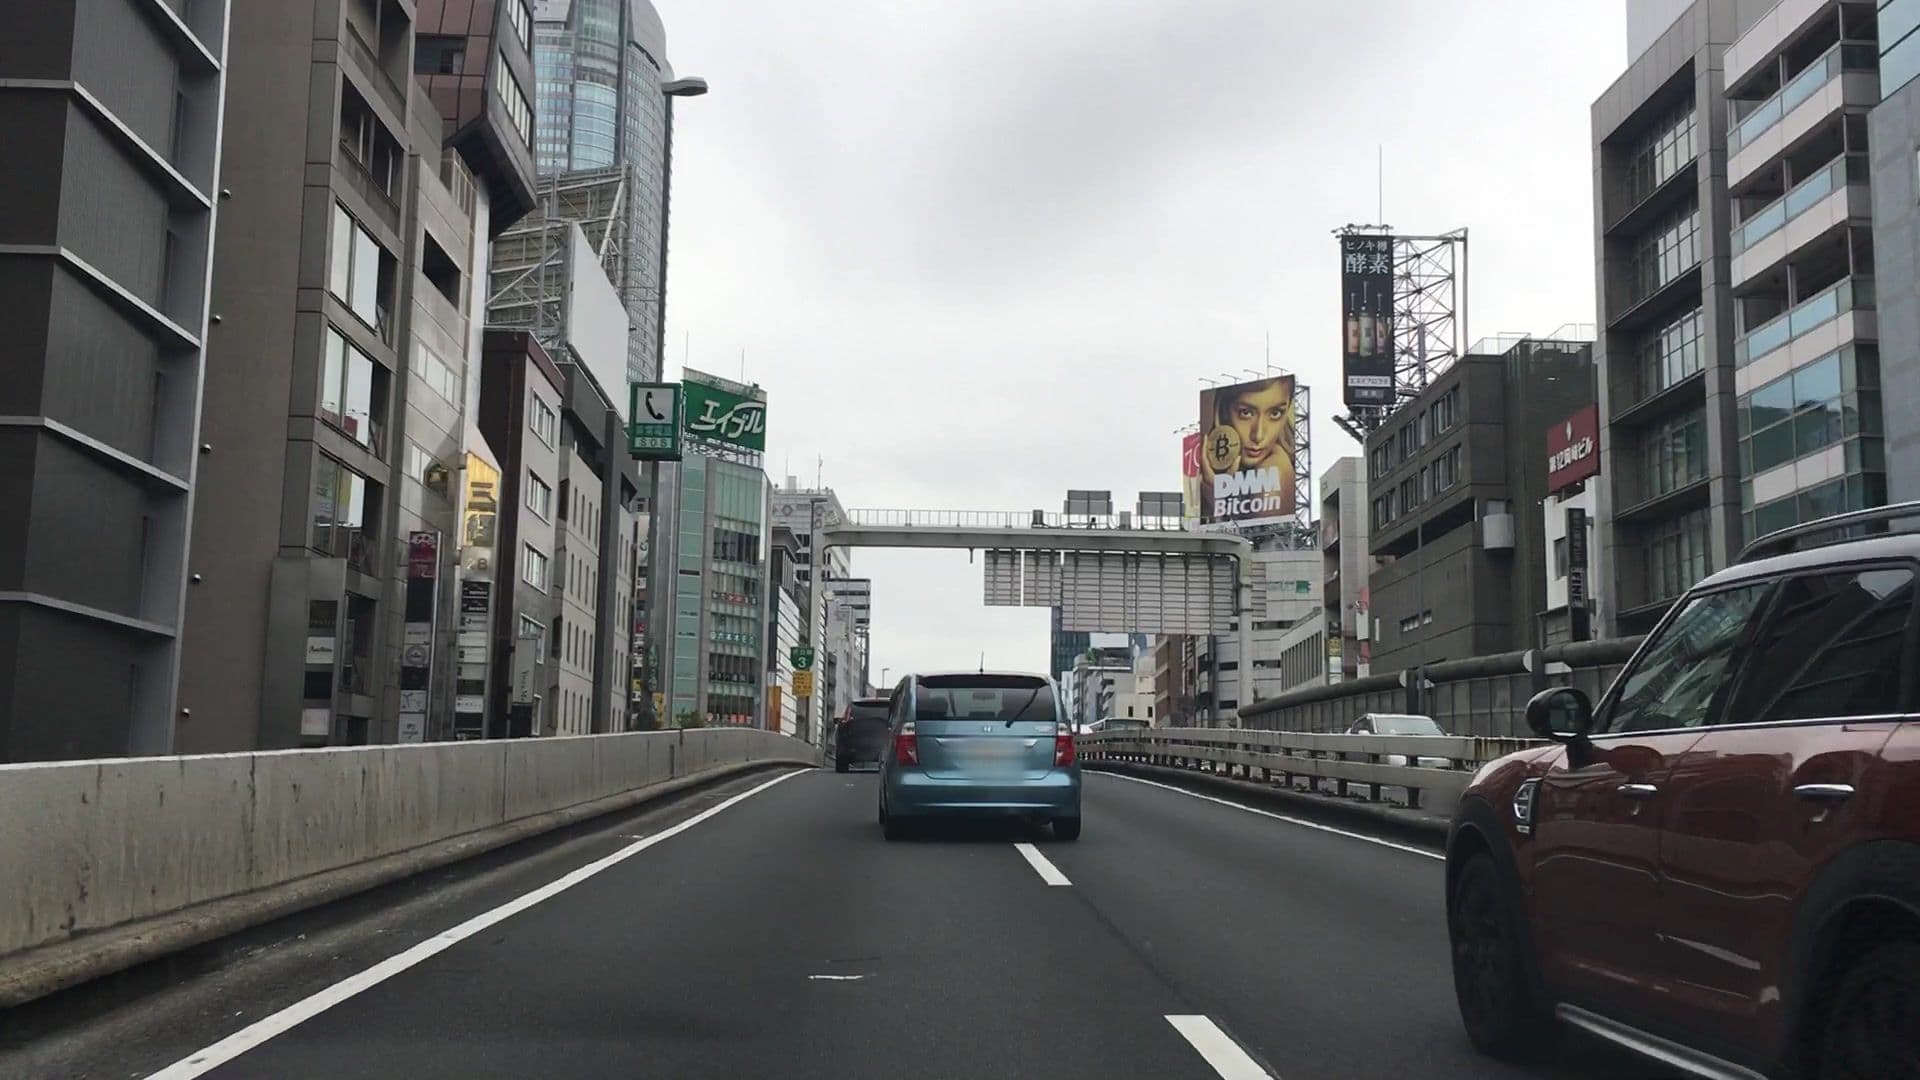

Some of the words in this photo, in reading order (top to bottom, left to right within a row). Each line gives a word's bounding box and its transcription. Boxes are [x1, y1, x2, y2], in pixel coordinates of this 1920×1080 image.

[1344, 253, 1389, 274] 酵素
[690, 400, 766, 438] エイブル
[640, 438, 668, 448] SOS
[1213, 466, 1281, 499] DMM
[1213, 493, 1281, 518] Bitcoin
[798, 656, 807, 669] 3
